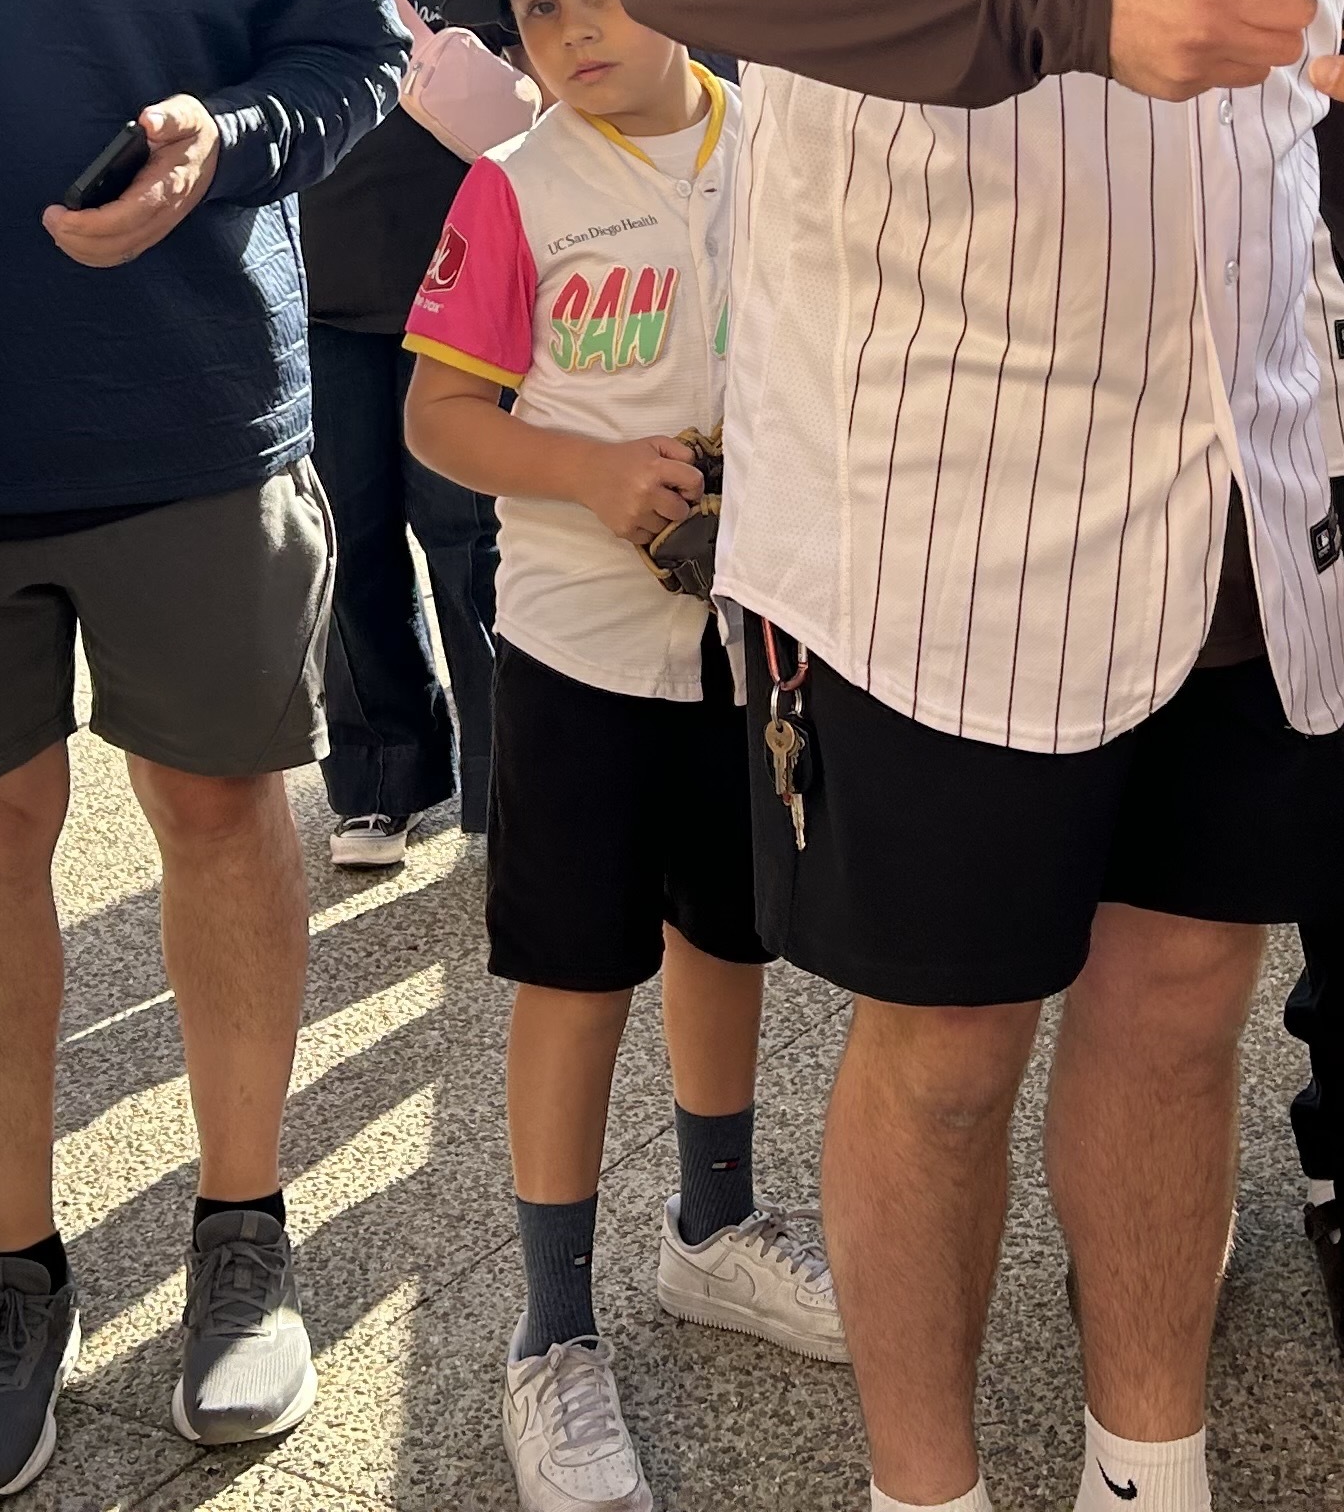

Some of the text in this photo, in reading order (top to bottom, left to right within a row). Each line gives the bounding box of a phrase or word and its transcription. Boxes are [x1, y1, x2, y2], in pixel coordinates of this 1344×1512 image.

[547, 214, 659, 256] UC San Diego Health
[548, 264, 681, 374] SAN
